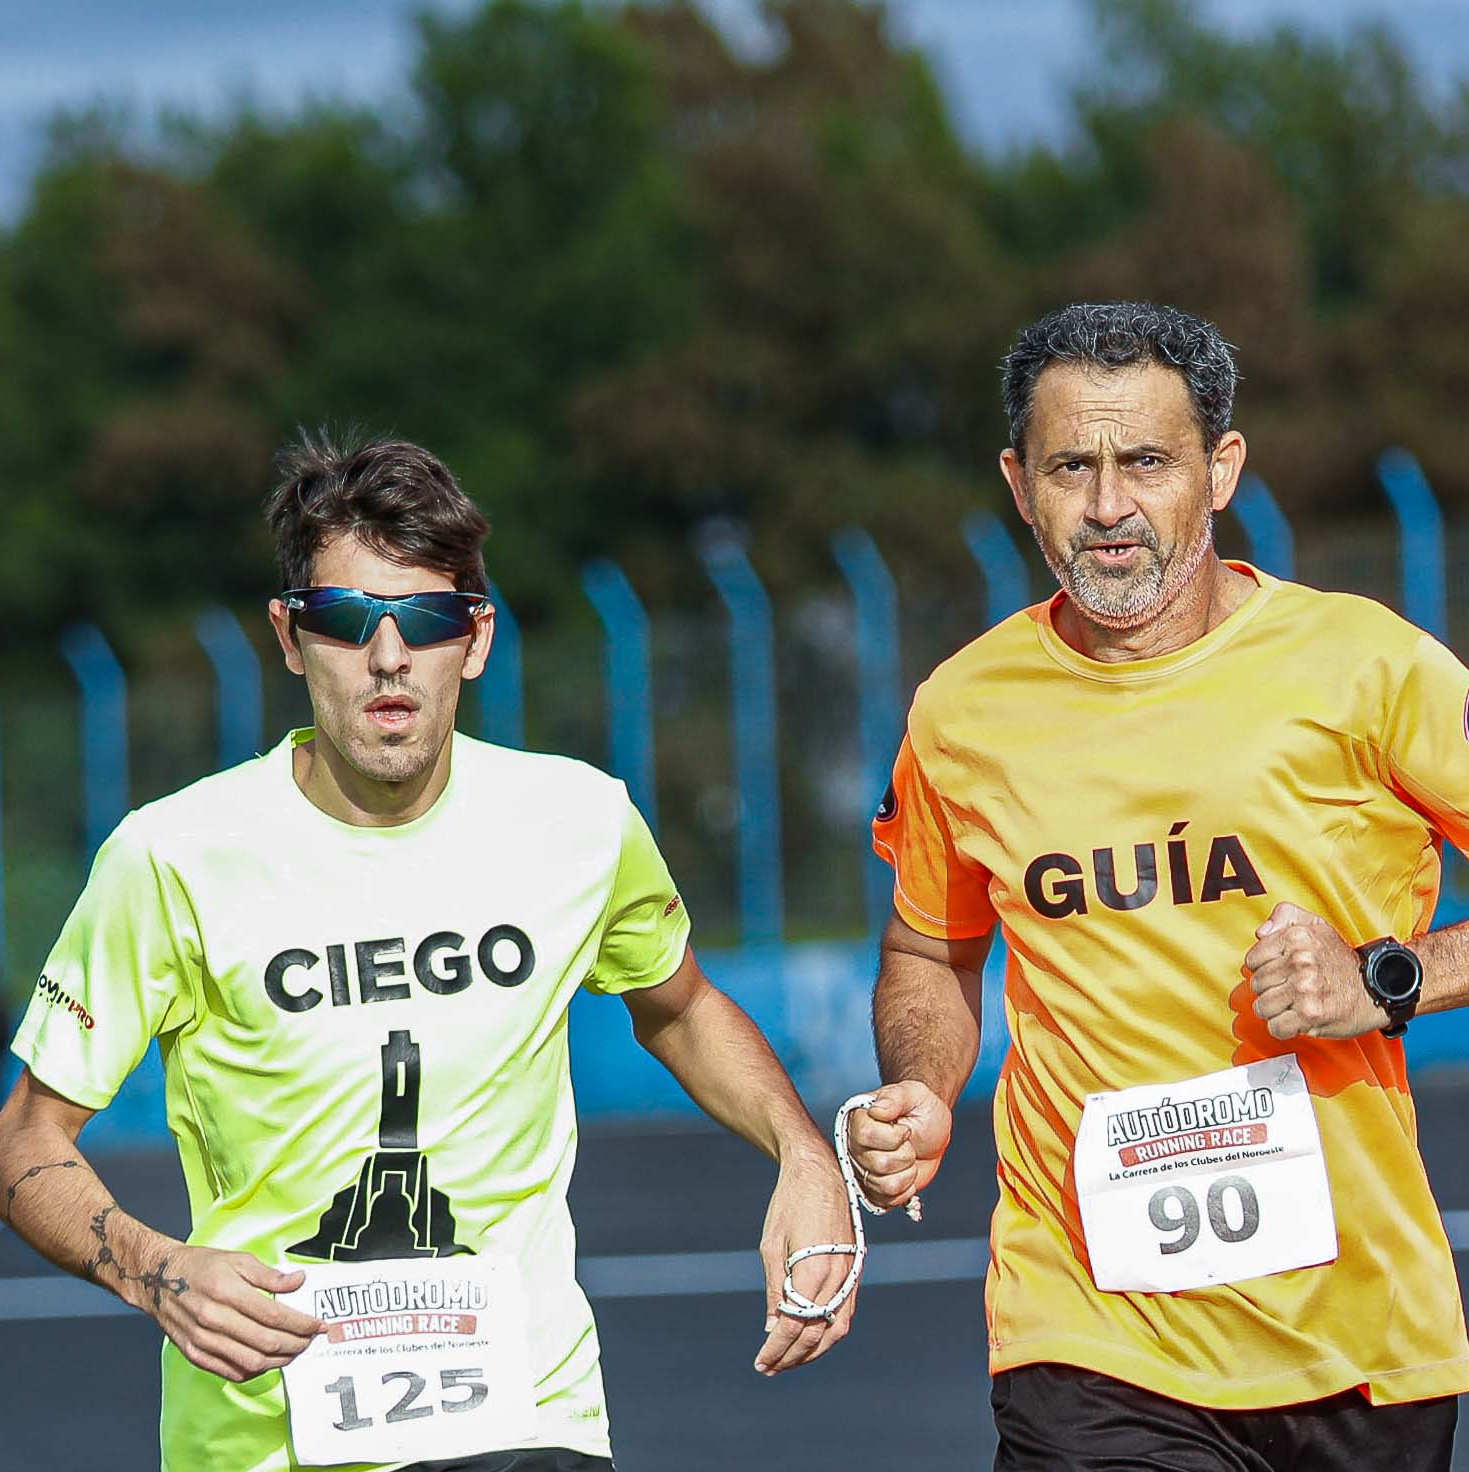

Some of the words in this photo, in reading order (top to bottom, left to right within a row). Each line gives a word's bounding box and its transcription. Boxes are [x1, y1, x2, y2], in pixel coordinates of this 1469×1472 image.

[1023, 820, 1268, 919] GUÍA
[264, 923, 536, 1013] CIEGO
[1107, 1087, 1275, 1147] AUTÓDROMO
[1109, 1172, 1120, 1181] La
[1122, 1167, 1158, 1179] Carrera
[1161, 1162, 1173, 1172] de
[1174, 1160, 1189, 1169] los
[1190, 1156, 1223, 1167] Clubes
[1225, 1152, 1240, 1162] del
[1242, 1146, 1284, 1159] Noroeste
[1135, 1133, 1206, 1163] RUNNING
[1212, 1127, 1252, 1147] RACE
[1148, 1175, 1260, 1255] 90
[315, 1277, 490, 1320] AUTÓDROMO
[342, 1314, 413, 1341] RUNNING
[419, 1315, 460, 1334] RACE
[365, 1347, 377, 1355] de
[380, 1345, 393, 1354] los
[396, 1344, 428, 1353] Clubes
[431, 1342, 445, 1350] del
[325, 1368, 488, 1431] 125
